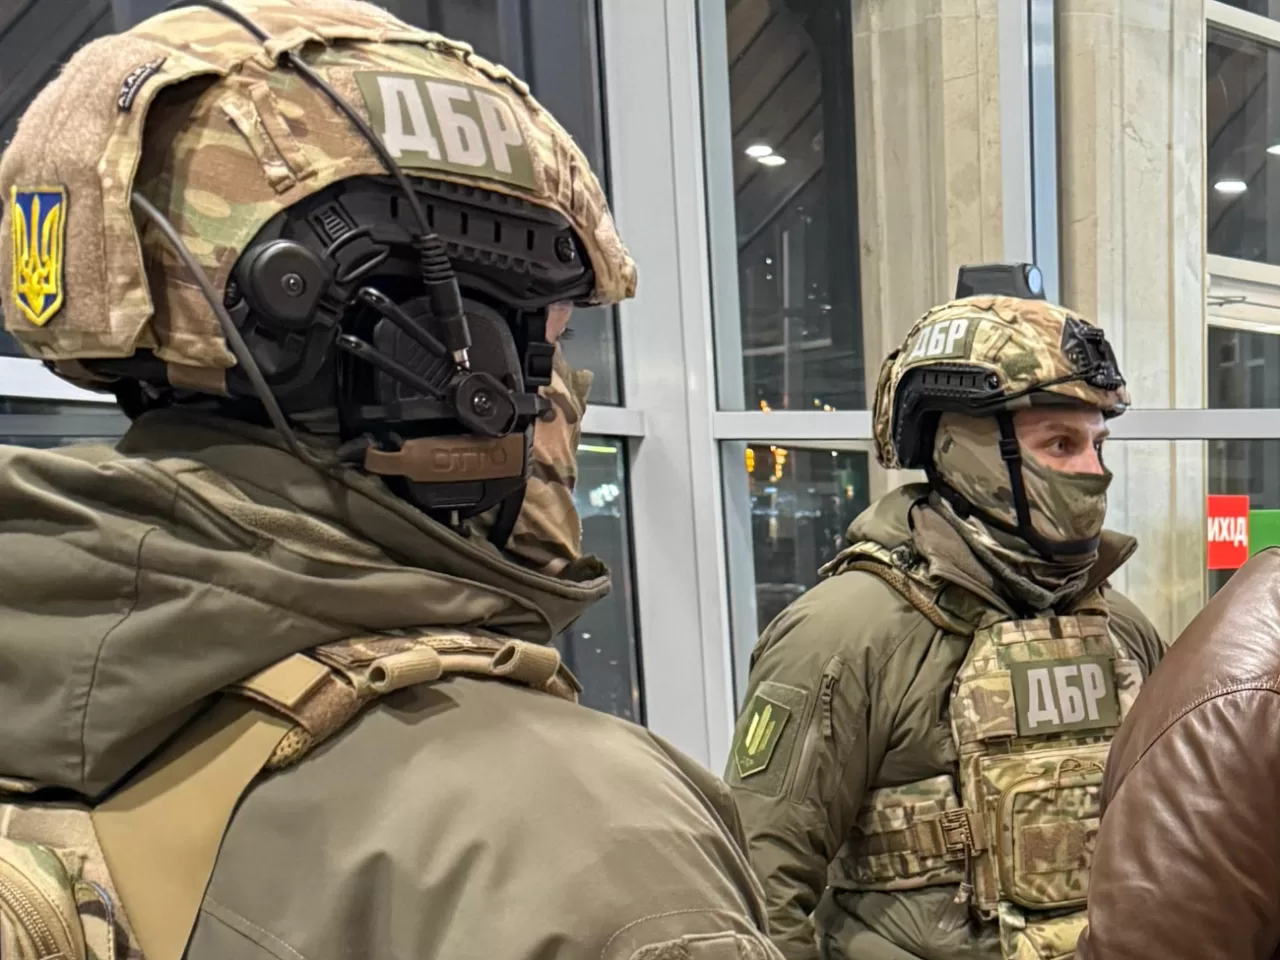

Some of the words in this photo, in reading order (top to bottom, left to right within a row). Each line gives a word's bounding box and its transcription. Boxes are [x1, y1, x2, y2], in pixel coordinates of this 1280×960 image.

[376, 76, 523, 174] ДБР
[907, 319, 969, 359] ДБР
[433, 447, 507, 472] OTTO
[1207, 517, 1248, 548] ИХІД
[1027, 663, 1106, 728] ДБР
